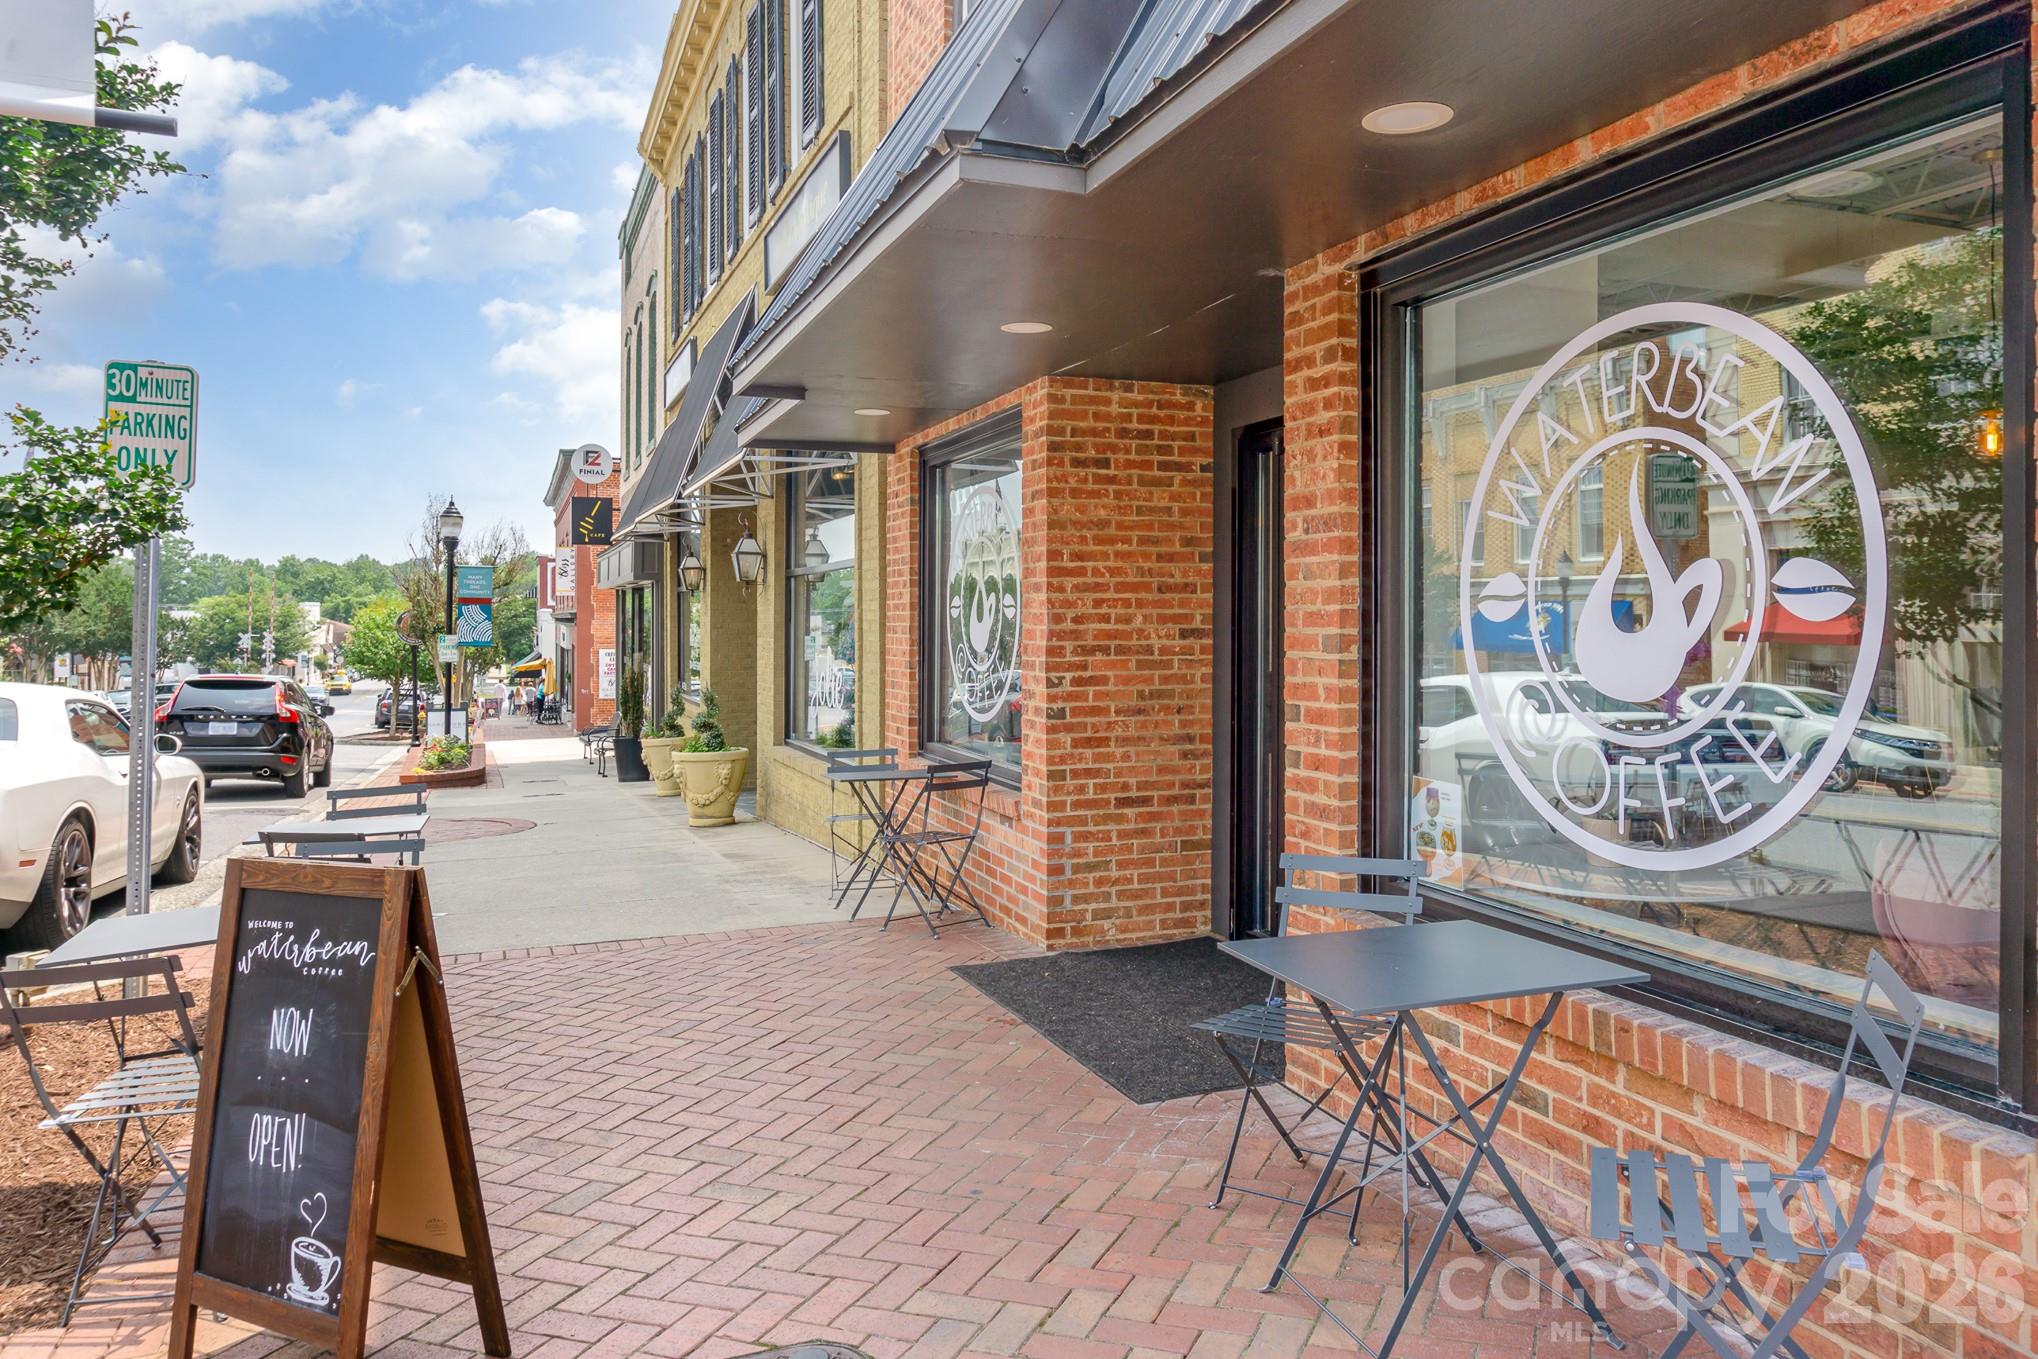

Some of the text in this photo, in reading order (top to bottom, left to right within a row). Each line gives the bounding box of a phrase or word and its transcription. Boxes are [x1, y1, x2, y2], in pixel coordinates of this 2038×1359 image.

[107, 368, 189, 401] 30 MINUTE
[109, 410, 188, 441] PARKING
[1487, 341, 1830, 528] WATERBEAN
[117, 445, 178, 475] ONLY
[579, 468, 605, 476] FINIAL
[954, 643, 1008, 709] COFFEE
[1506, 681, 1802, 839] COFFEE
[247, 919, 294, 929] WELCOME TO
[238, 928, 376, 974] waterbean
[269, 1007, 314, 1057] NOW
[248, 1112, 306, 1173] OPEN!
